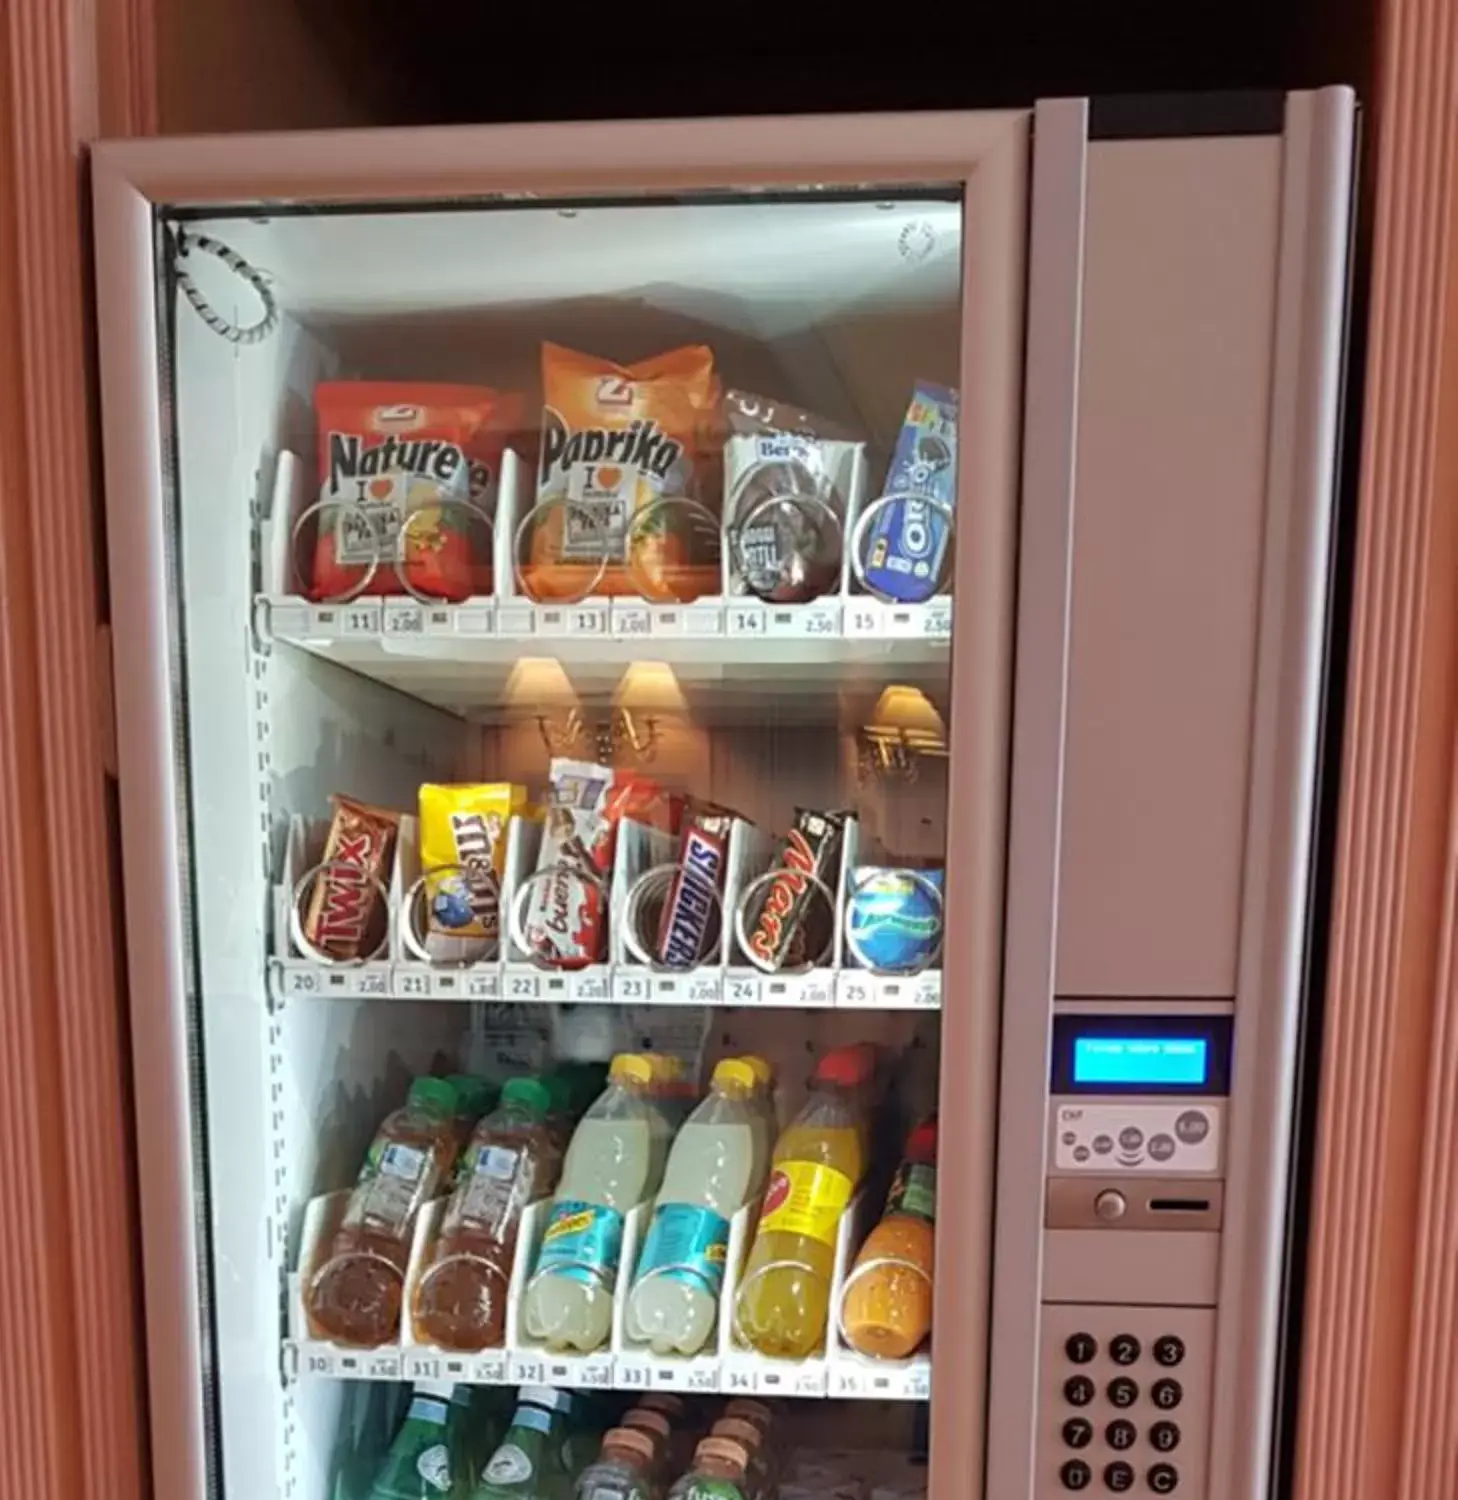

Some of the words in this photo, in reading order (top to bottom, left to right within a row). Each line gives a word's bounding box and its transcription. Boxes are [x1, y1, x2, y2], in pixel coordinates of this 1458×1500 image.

[540, 420, 684, 485] Paprika
[329, 432, 462, 494] Nature
[351, 614, 370, 629] 11
[577, 613, 596, 629] 13
[737, 614, 757, 629] 14
[806, 619, 833, 633] 2.50
[854, 614, 874, 629] 15
[750, 829, 816, 960] Mars
[665, 840, 720, 969] SNICKERS
[294, 975, 313, 991] 20
[403, 976, 422, 992] 21
[512, 978, 531, 994] 22
[622, 981, 642, 996] 23
[732, 982, 753, 997] 24
[846, 985, 866, 1000] 25
[1077, 1341, 1085, 1360] 1
[1118, 1342, 1133, 1362] 2
[1163, 1343, 1178, 1362] 3
[517, 1362, 536, 1378] 32
[622, 1368, 642, 1383] 33
[729, 1371, 748, 1387] 34
[1072, 1384, 1086, 1402] 4
[1115, 1385, 1131, 1404] 5
[1158, 1386, 1174, 1405] 6
[1071, 1425, 1086, 1445] 7
[1114, 1427, 1129, 1447] 8
[1158, 1429, 1173, 1448] 9
[1067, 1468, 1083, 1487] 0
[1111, 1469, 1127, 1488] E
[1153, 1471, 1171, 1490] C
